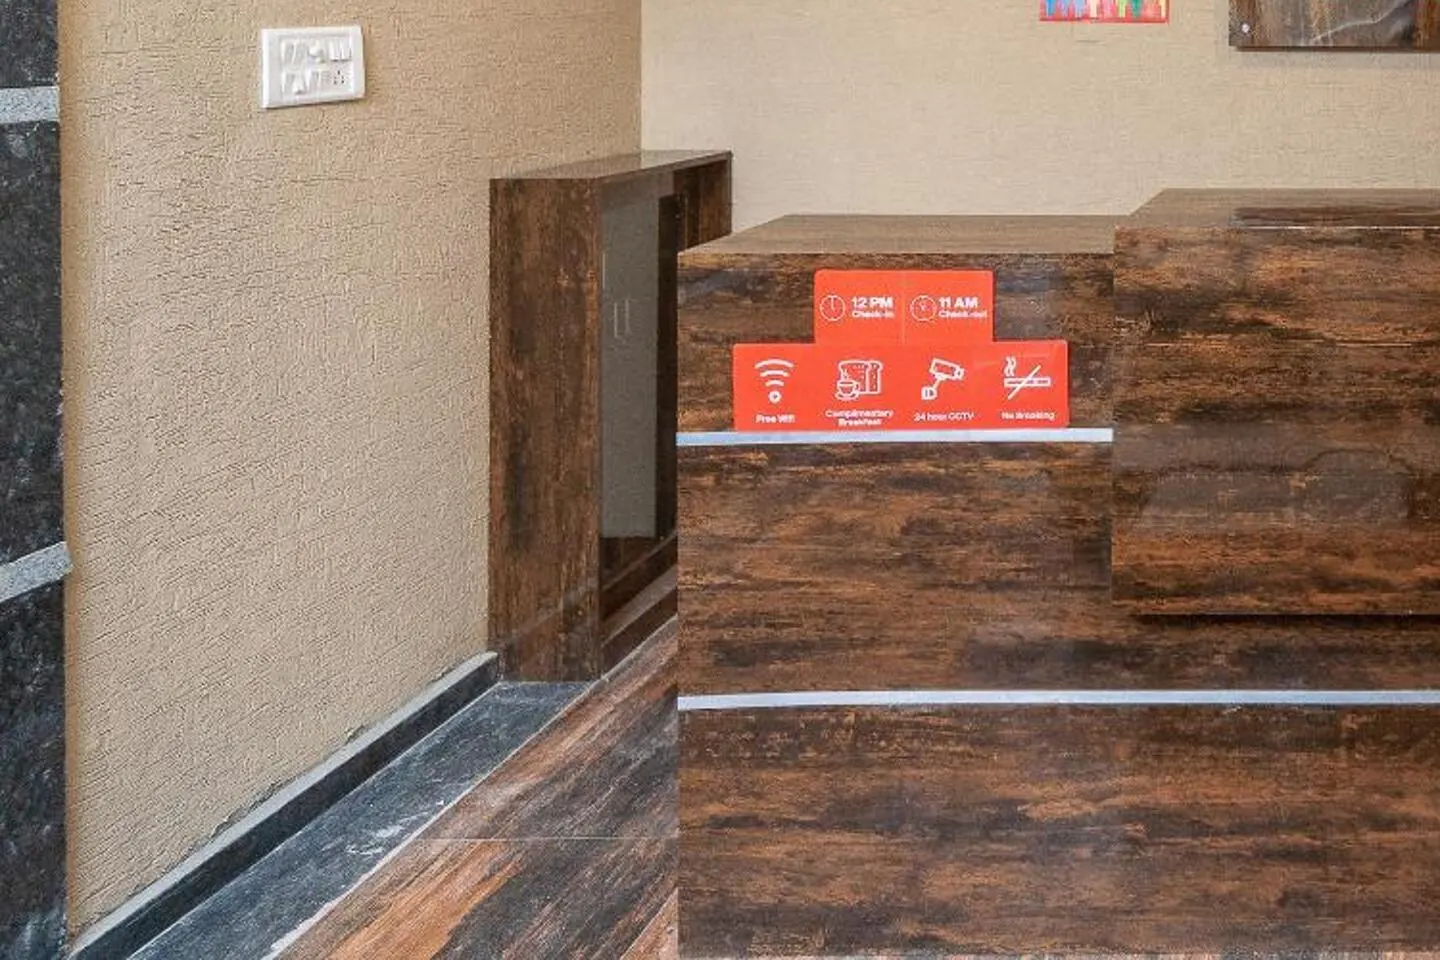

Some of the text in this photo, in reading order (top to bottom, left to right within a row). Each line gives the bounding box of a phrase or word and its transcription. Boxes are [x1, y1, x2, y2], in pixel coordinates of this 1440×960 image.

[851, 296, 894, 309] 12 PM
[939, 296, 979, 308] 11 AM
[755, 414, 776, 423] Free
